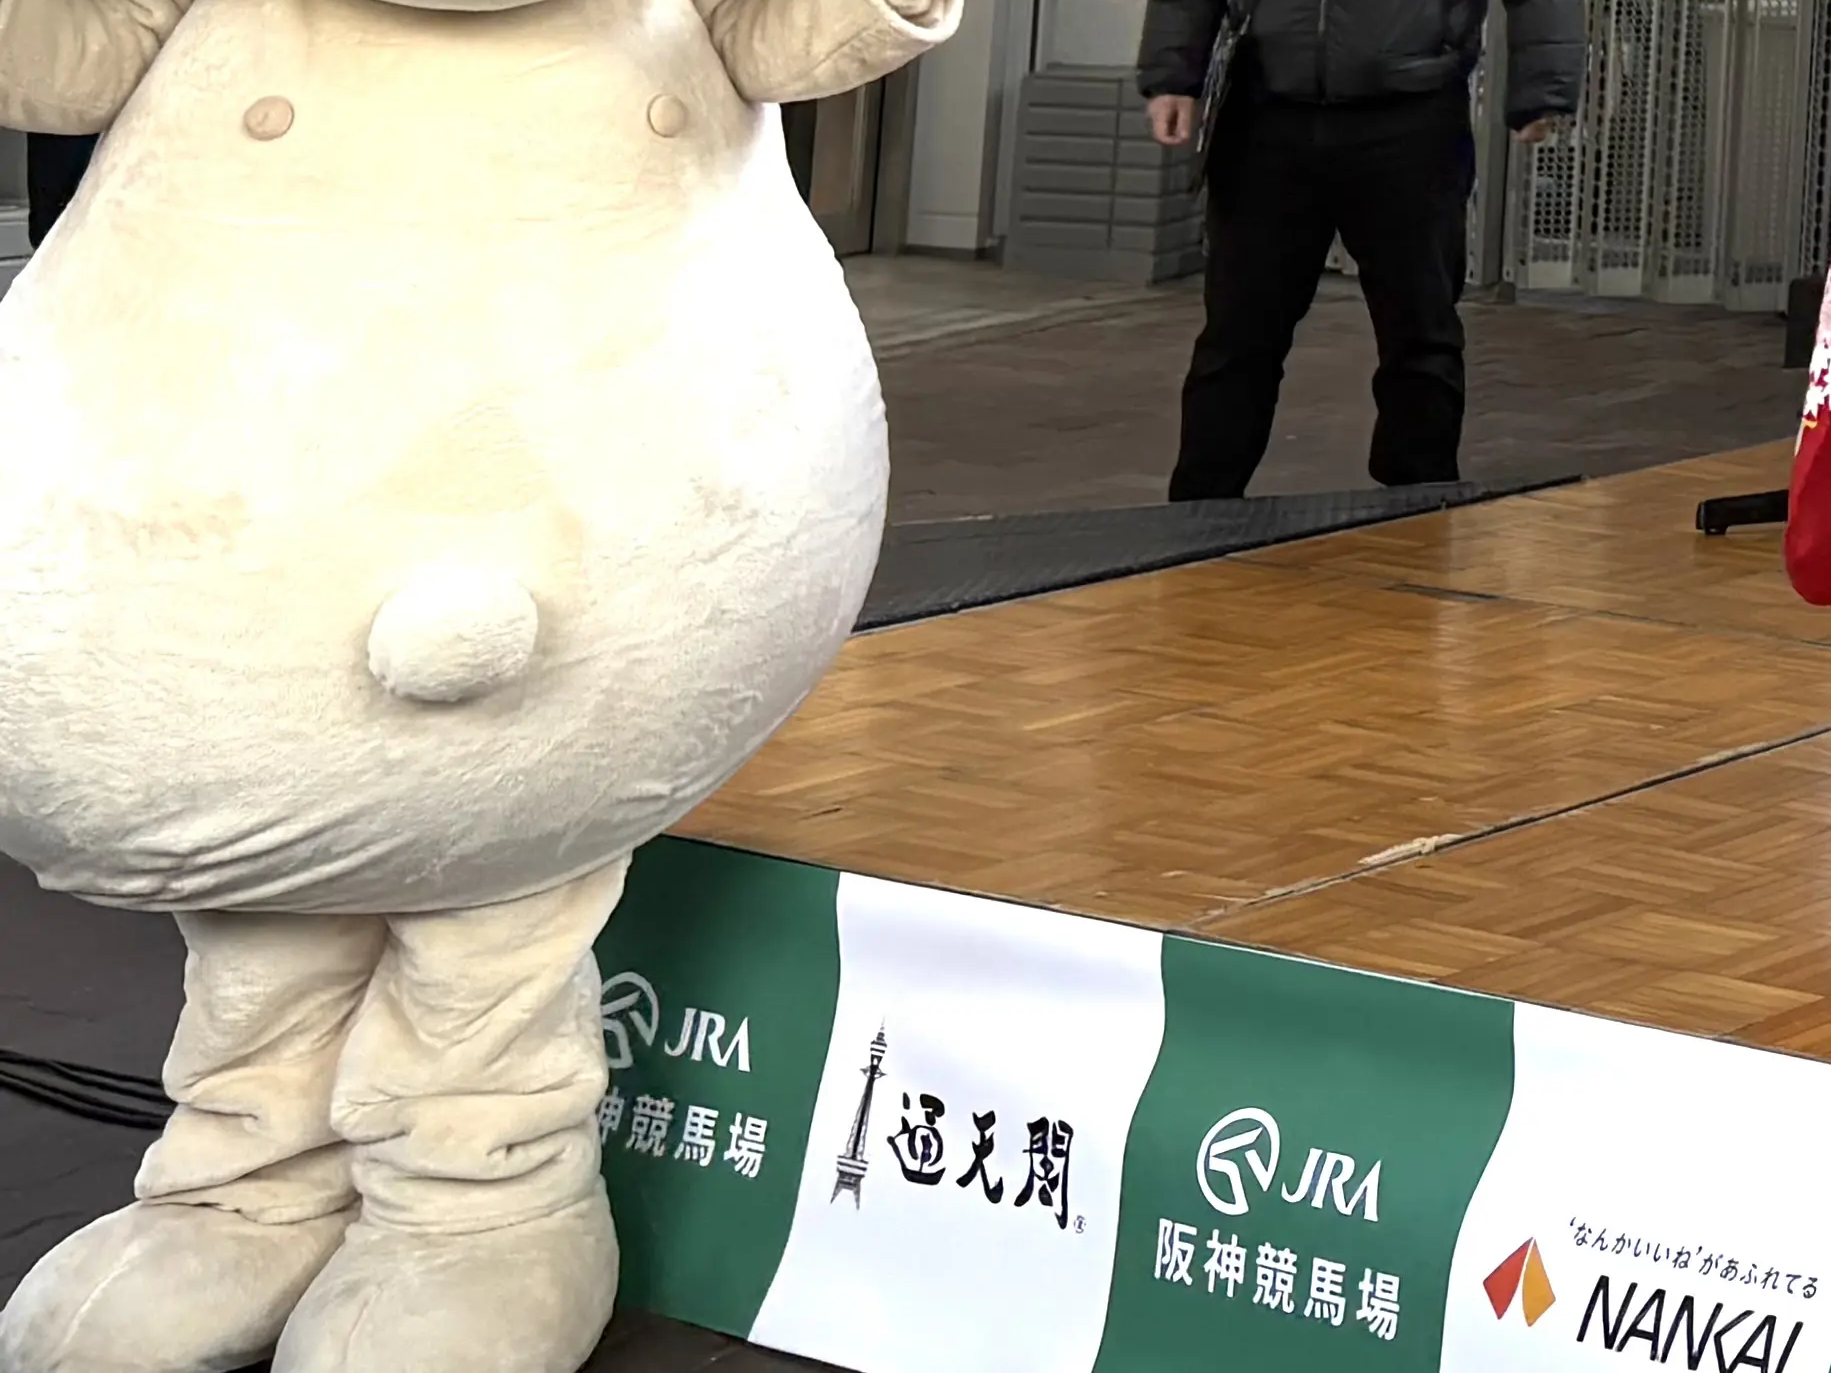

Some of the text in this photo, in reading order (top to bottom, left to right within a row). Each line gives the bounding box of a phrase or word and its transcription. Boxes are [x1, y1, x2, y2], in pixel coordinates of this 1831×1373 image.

[664, 1007, 752, 1073] JRA
[886, 1092, 1074, 1230] 通天閣
[1281, 1147, 1382, 1223] JRA
[1154, 1217, 1401, 1342] 阪神競馬場
[1576, 1274, 1804, 1373] NANKAI
